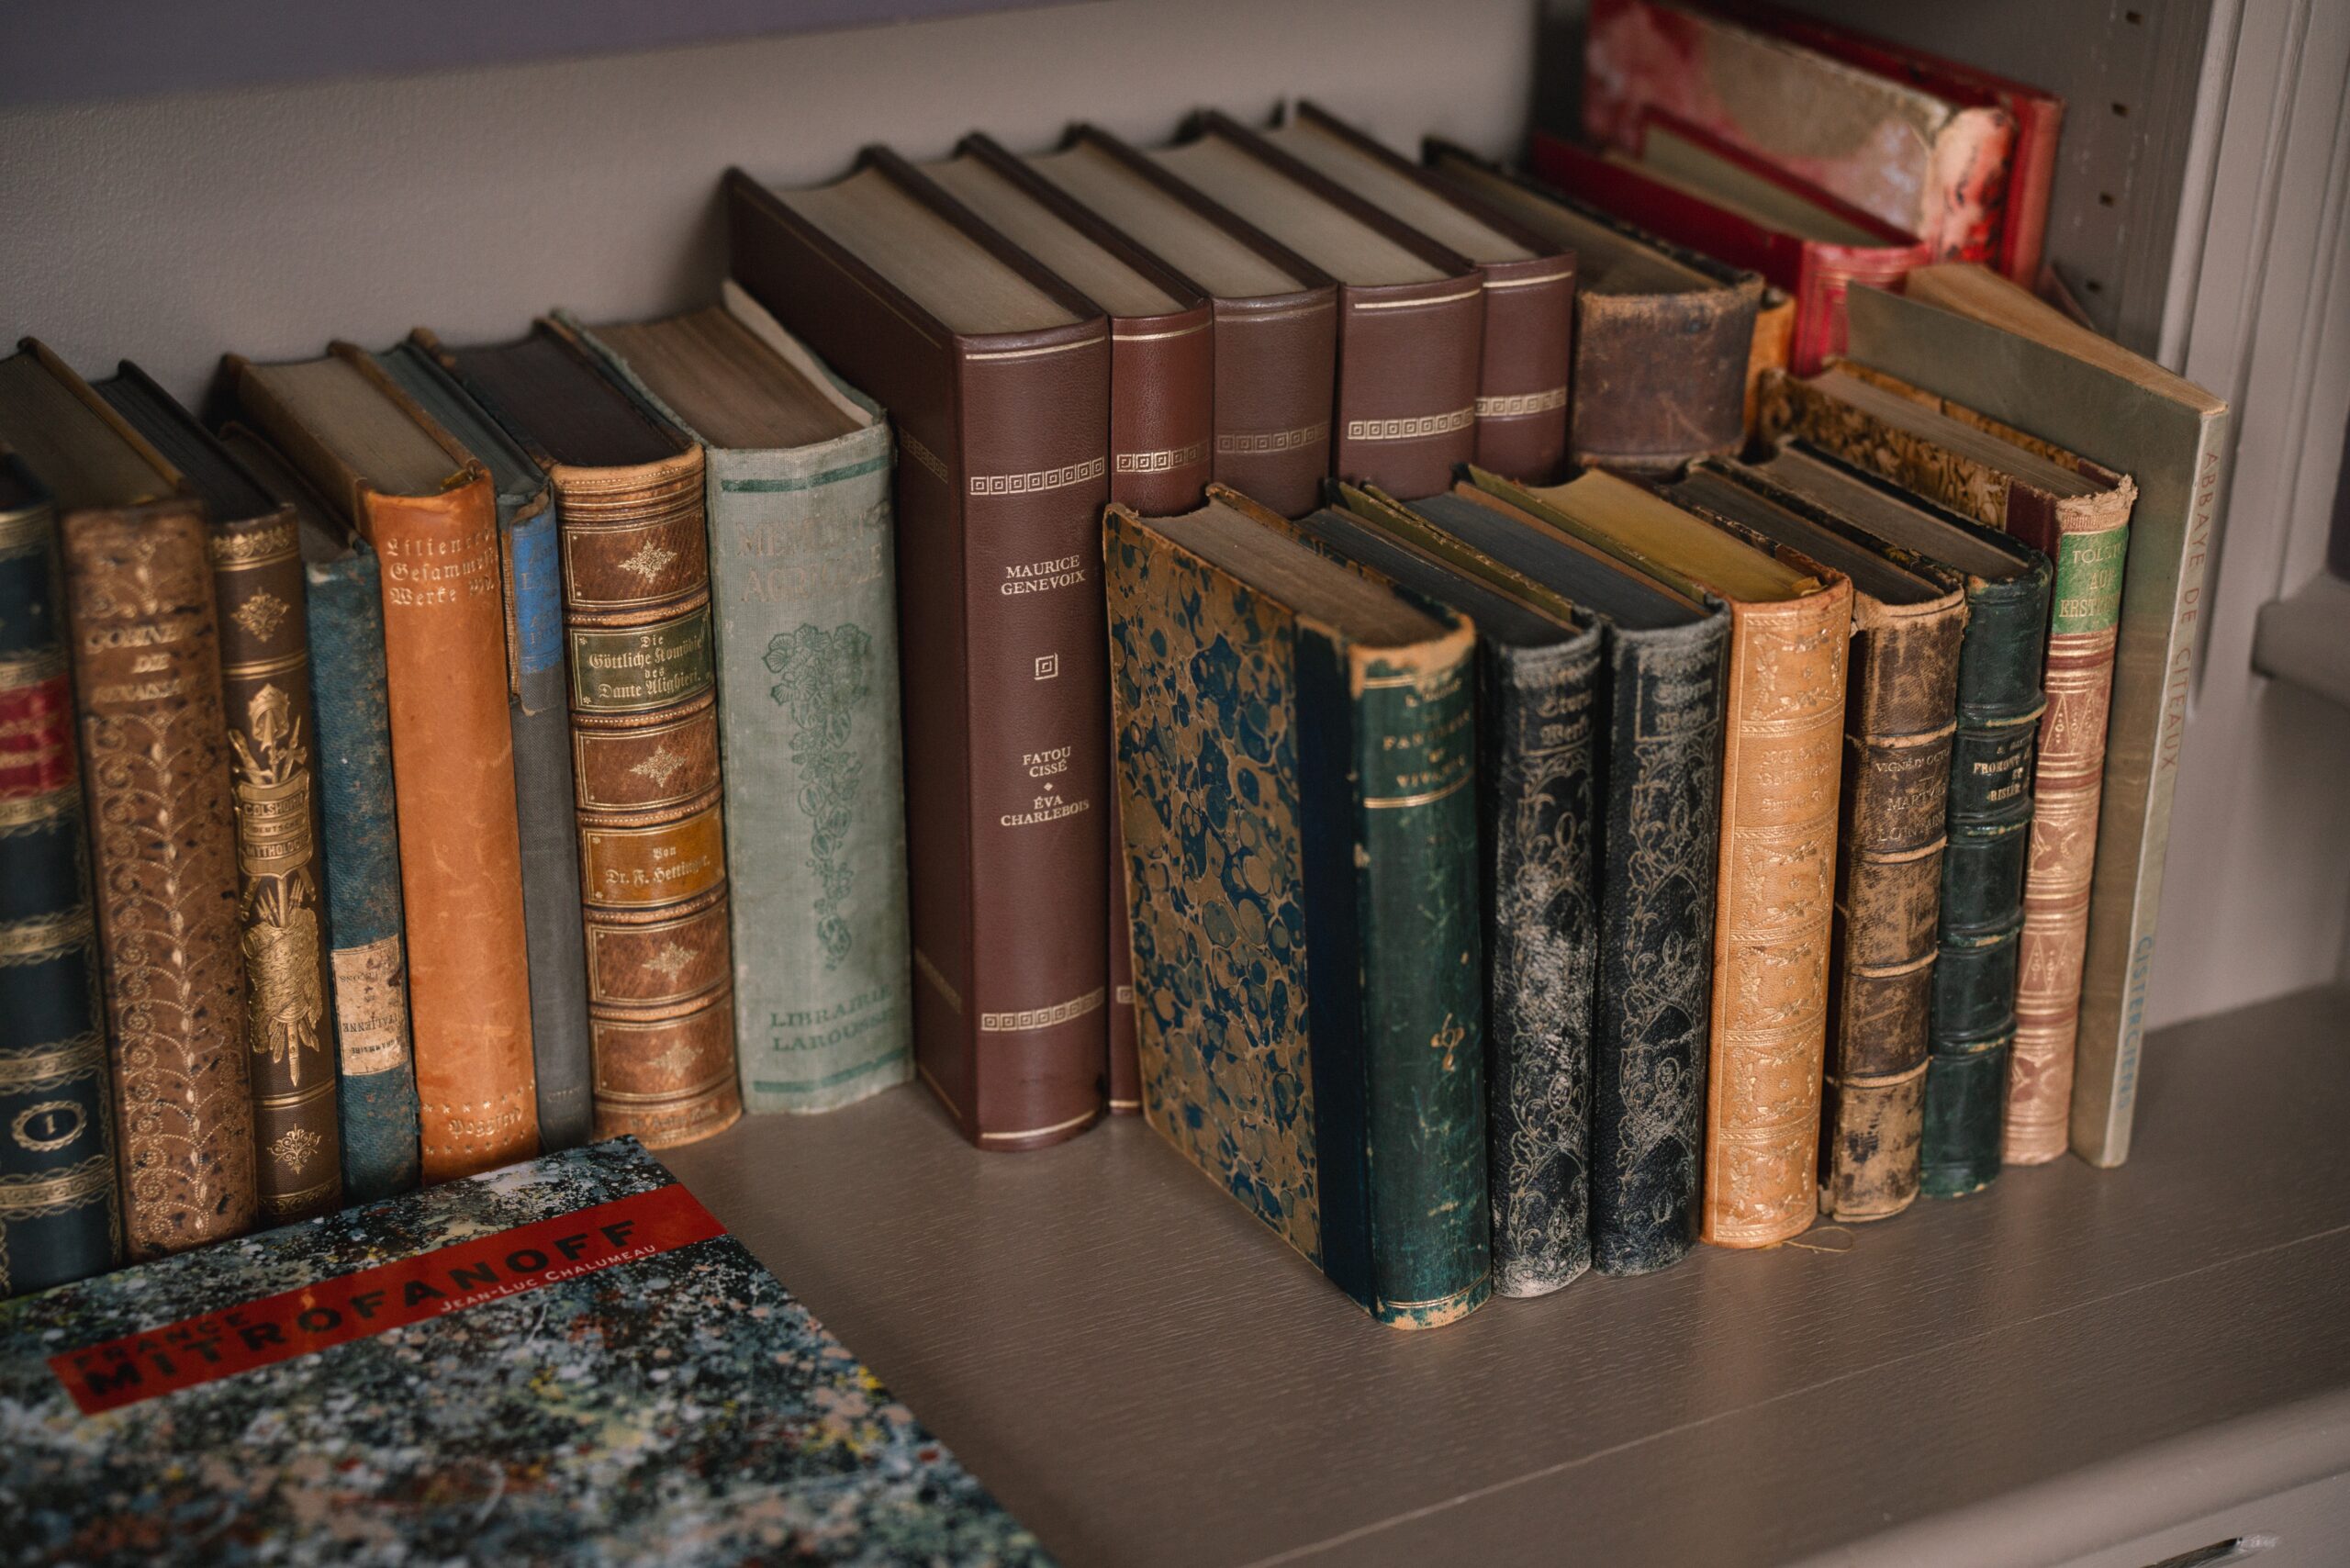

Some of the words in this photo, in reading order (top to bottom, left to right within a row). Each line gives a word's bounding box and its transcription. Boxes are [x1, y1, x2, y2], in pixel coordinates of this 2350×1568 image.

[2188, 453, 2219, 567] ABBAYE
[1006, 554, 1080, 579] MAURICE
[1001, 569, 1086, 596] GENEVOIX
[389, 586, 456, 606] Werke
[2181, 588, 2199, 624] DE
[640, 634, 664, 648] Die
[588, 651, 651, 669] Göttliche
[644, 666, 665, 678] des
[599, 683, 642, 699] Dante
[2161, 647, 2191, 770] CITEAUX
[1023, 746, 1071, 766] FATOU
[1029, 759, 1068, 778] CISSÉ
[1034, 795, 1063, 810] ÉVA
[1001, 800, 1090, 827] CHARLEBOIS
[604, 868, 630, 884] Dr.
[342, 1013, 398, 1033] ITALIENNE
[84, 1219, 636, 1396] MITROFANOFF
